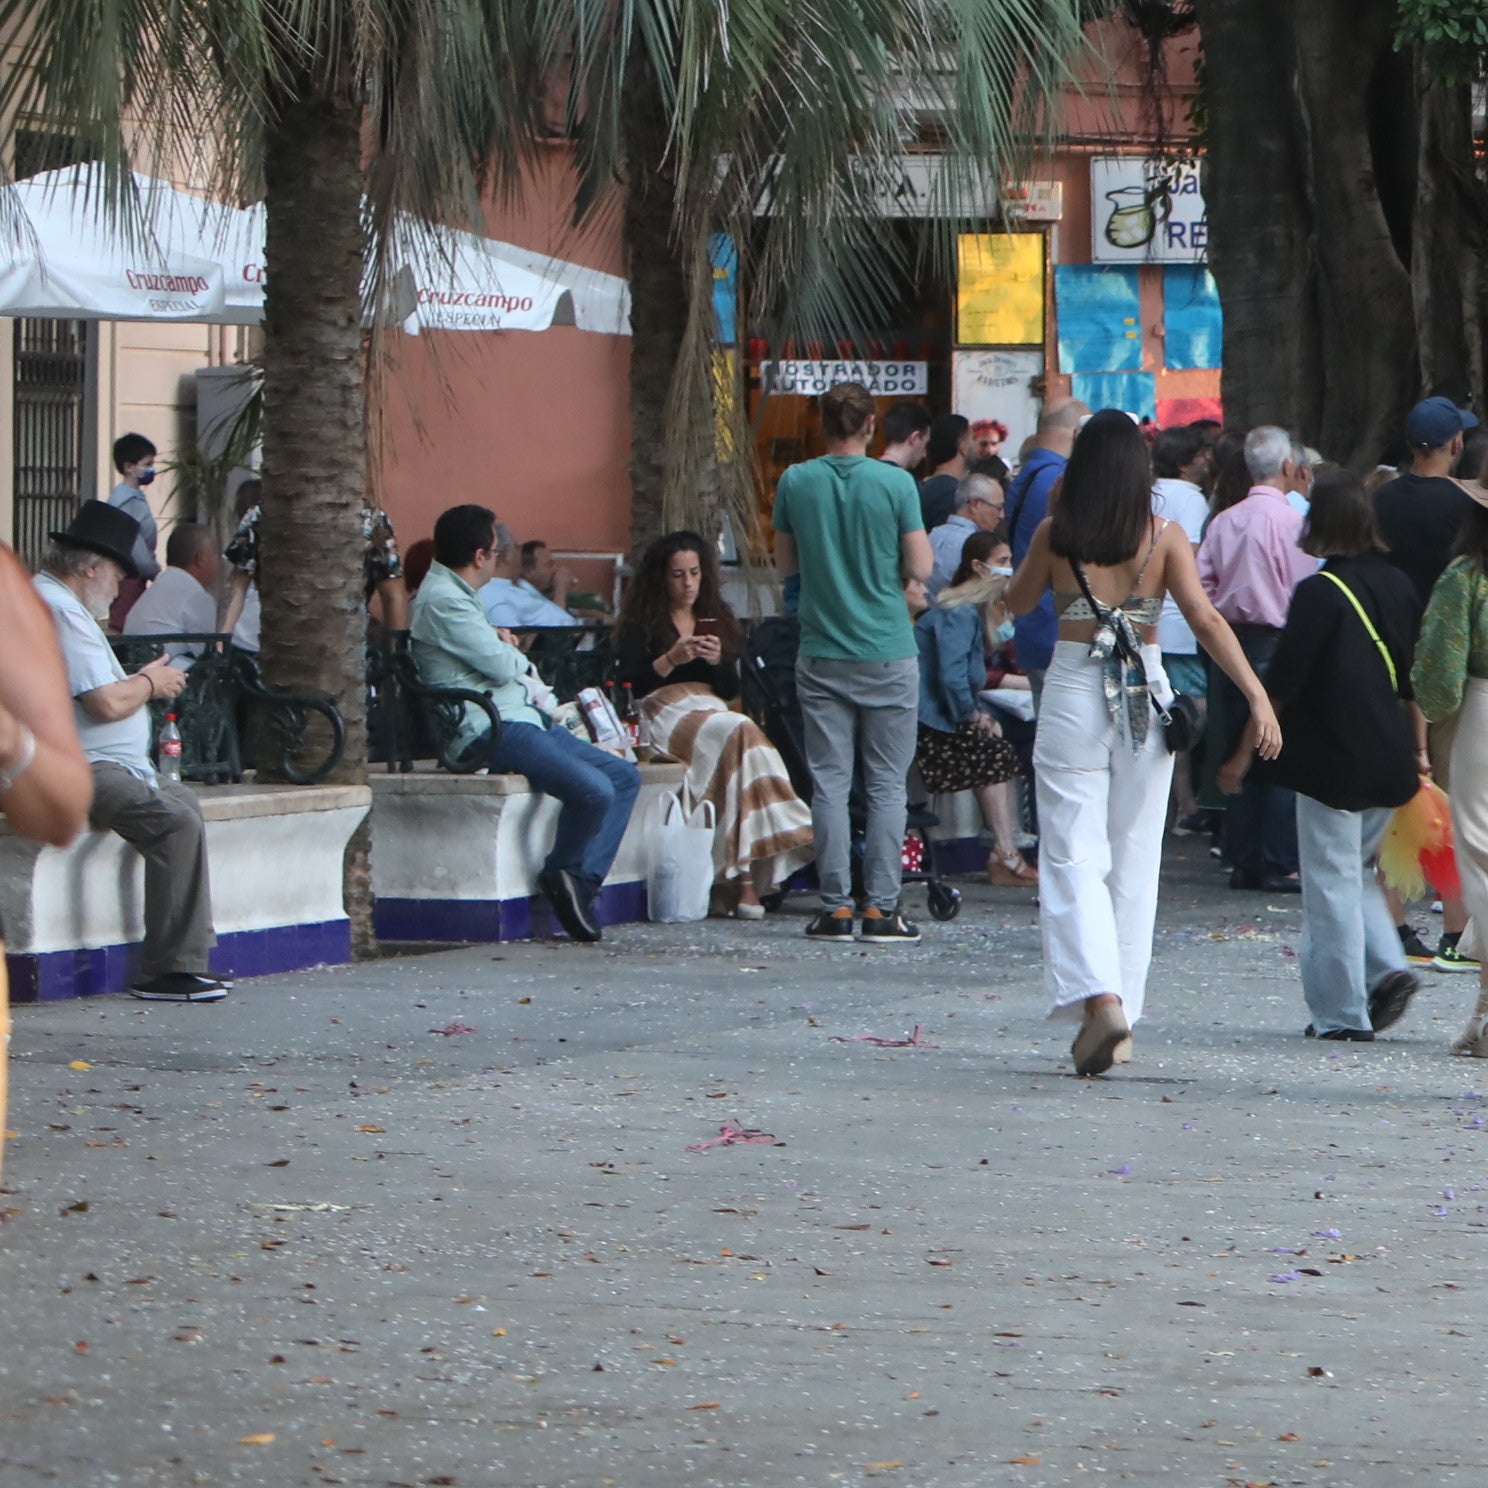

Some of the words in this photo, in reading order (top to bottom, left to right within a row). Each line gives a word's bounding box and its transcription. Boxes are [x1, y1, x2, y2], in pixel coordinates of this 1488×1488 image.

[125, 269, 209, 295] Cruzcampo
[150, 299, 202, 312] ESPECIAL
[417, 287, 533, 313] Cruzcampo
[767, 378, 923, 392] UTOADO.
